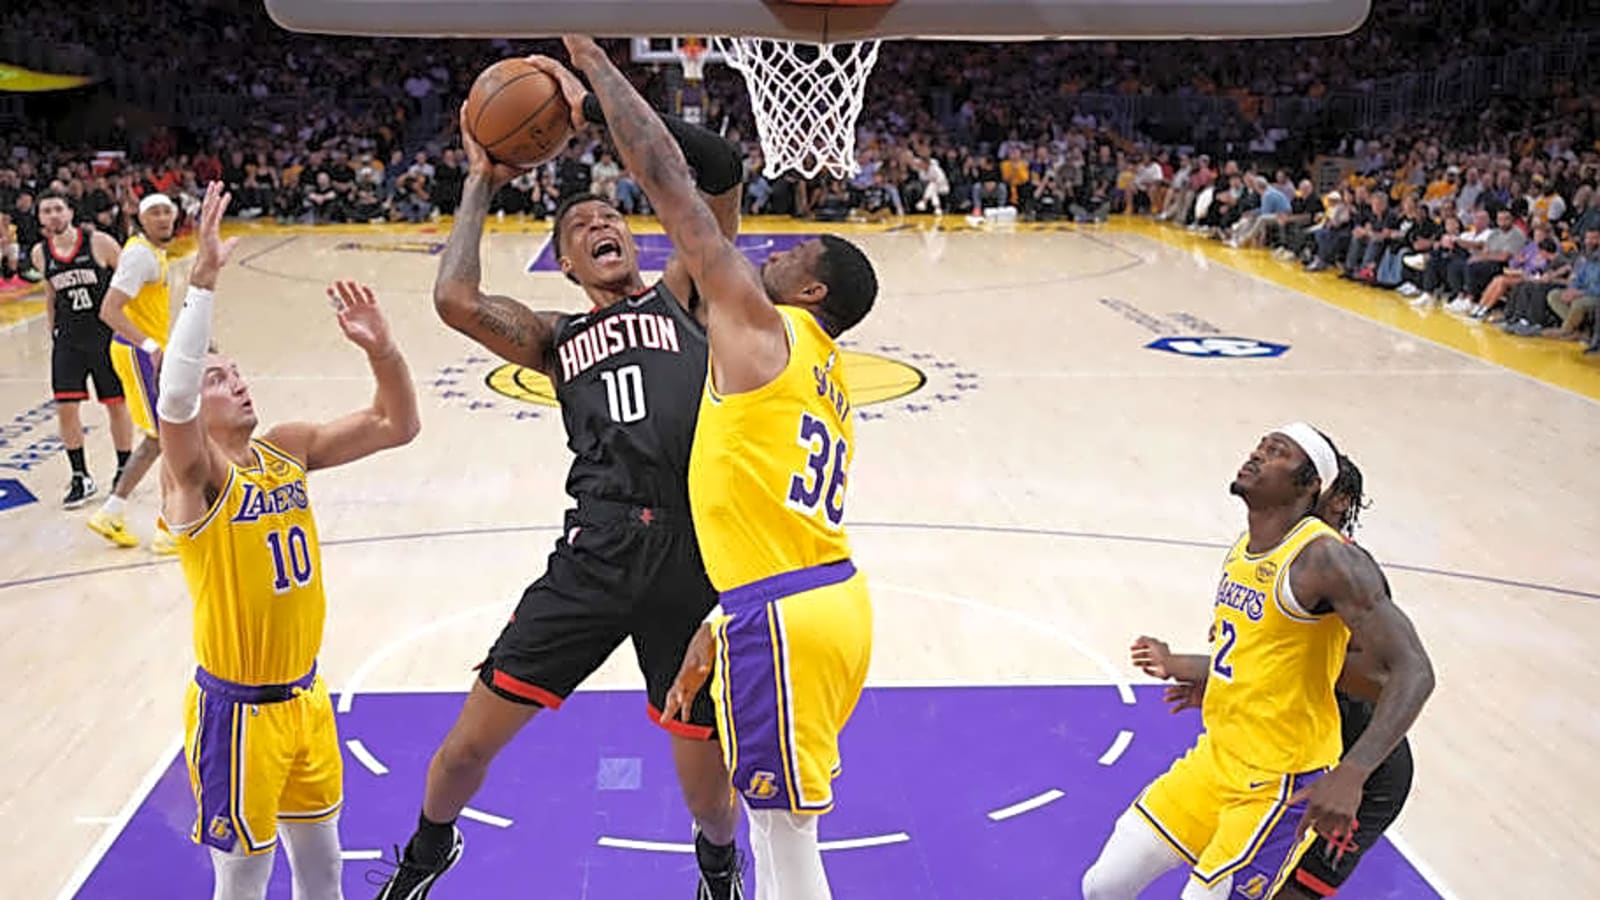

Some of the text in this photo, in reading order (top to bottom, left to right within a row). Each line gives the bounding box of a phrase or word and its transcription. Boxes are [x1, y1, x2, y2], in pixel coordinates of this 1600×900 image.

[67, 287, 93, 311] 28
[558, 313, 681, 383] HOUSTON
[601, 363, 647, 424] 10
[230, 478, 309, 523] LAERS
[785, 412, 849, 531] 36
[267, 525, 312, 595] 10
[1212, 618, 1236, 682] 2
